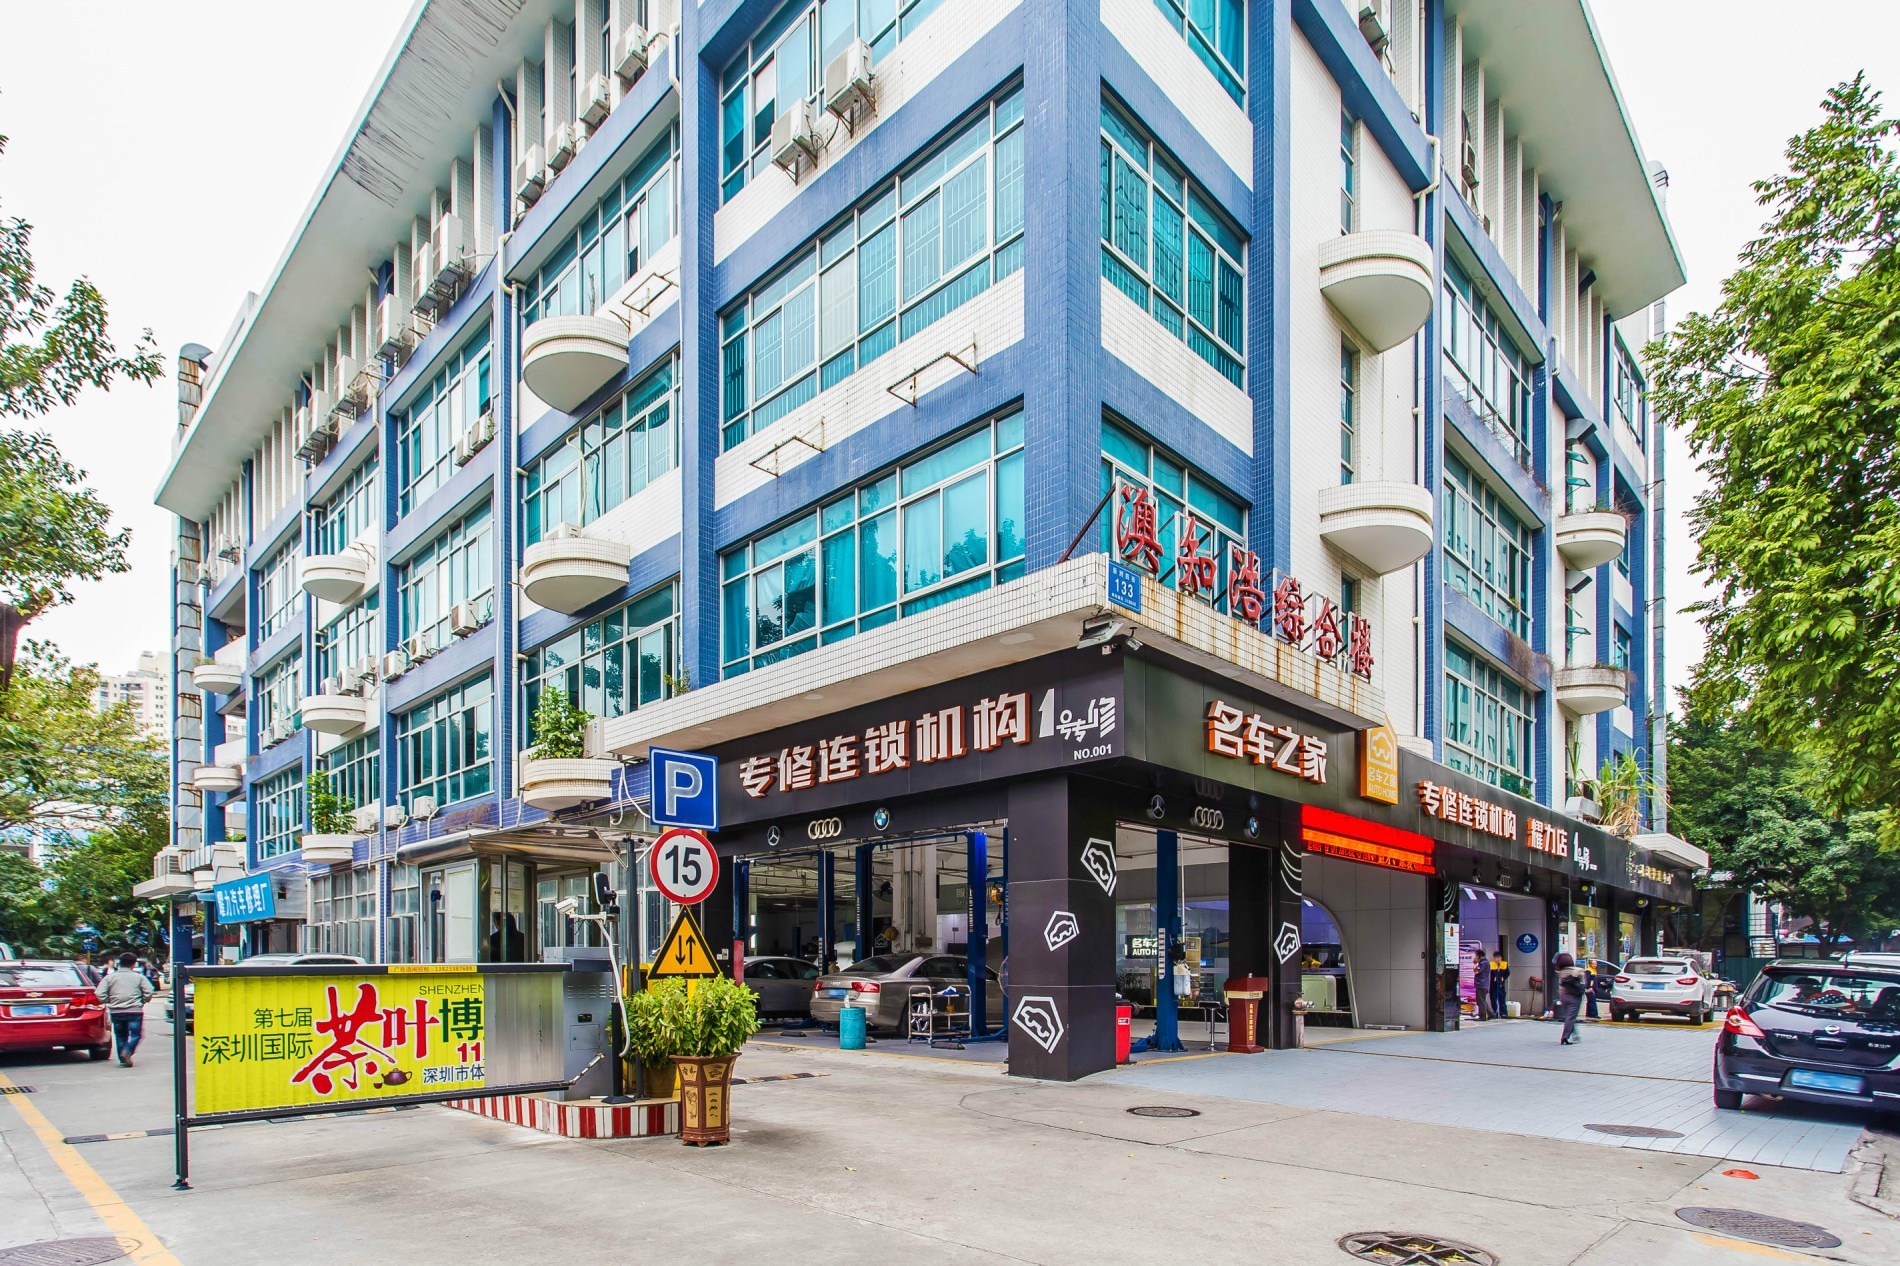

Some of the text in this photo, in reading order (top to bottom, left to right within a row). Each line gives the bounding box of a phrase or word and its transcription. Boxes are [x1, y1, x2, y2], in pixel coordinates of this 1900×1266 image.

[1115, 579, 1133, 598] 133
[740, 692, 1030, 798] 专修连锁机构
[1073, 744, 1112, 760] NO.001
[1208, 700, 1327, 783] 名车之家
[665, 760, 702, 816] P
[1419, 781, 1517, 841] 专修连锁机构
[1527, 818, 1568, 858] 耀力店
[665, 845, 701, 886] 15
[253, 1007, 312, 1029] 第七届
[201, 1032, 313, 1065] 深圳国际
[423, 1064, 485, 1083] 深圳市体
